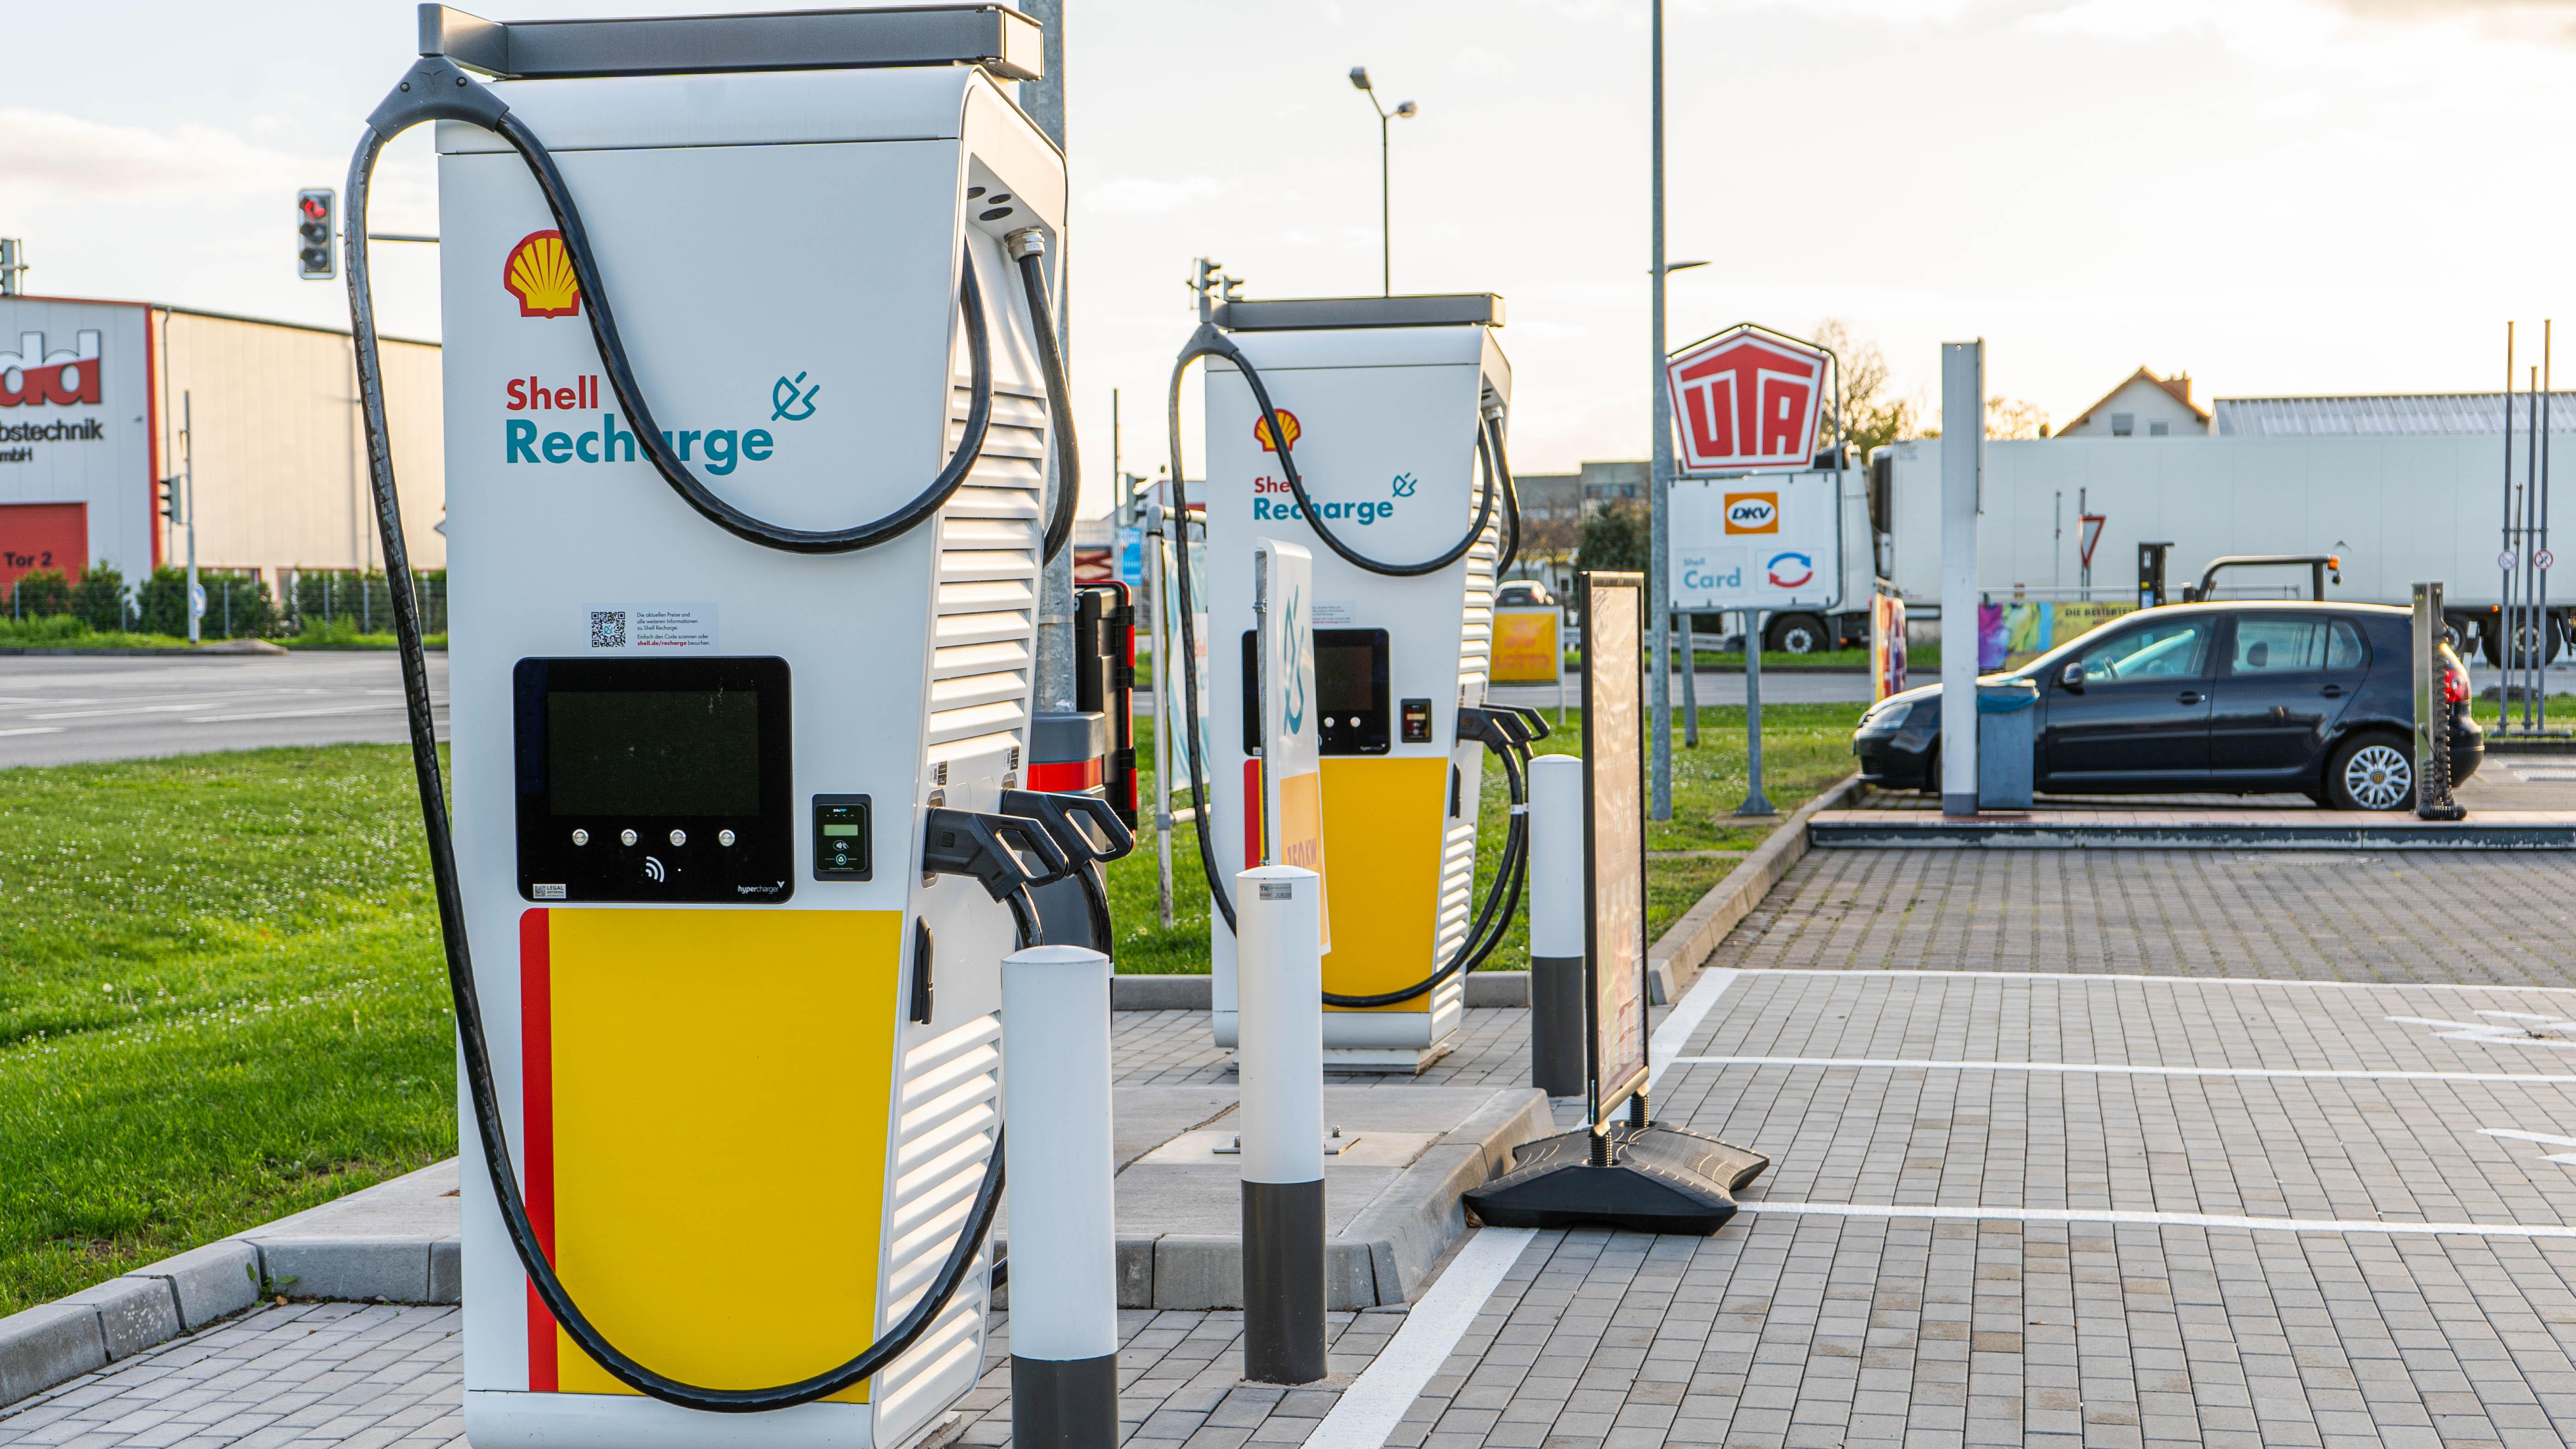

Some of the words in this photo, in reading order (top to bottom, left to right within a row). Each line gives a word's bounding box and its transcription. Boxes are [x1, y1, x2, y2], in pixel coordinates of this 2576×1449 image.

[506, 375, 599, 411] Shell
[1680, 343, 1814, 457] UTA
[1732, 506, 1772, 520] DKV
[4, 551, 35, 568] Tor
[42, 551, 52, 567] 2
[1683, 556, 1706, 567] Shell
[1683, 567, 1741, 589] Card
[2065, 607, 2081, 617] DIE
[1494, 654, 1550, 670] LOTTO
[738, 885, 779, 894] hypercharger
